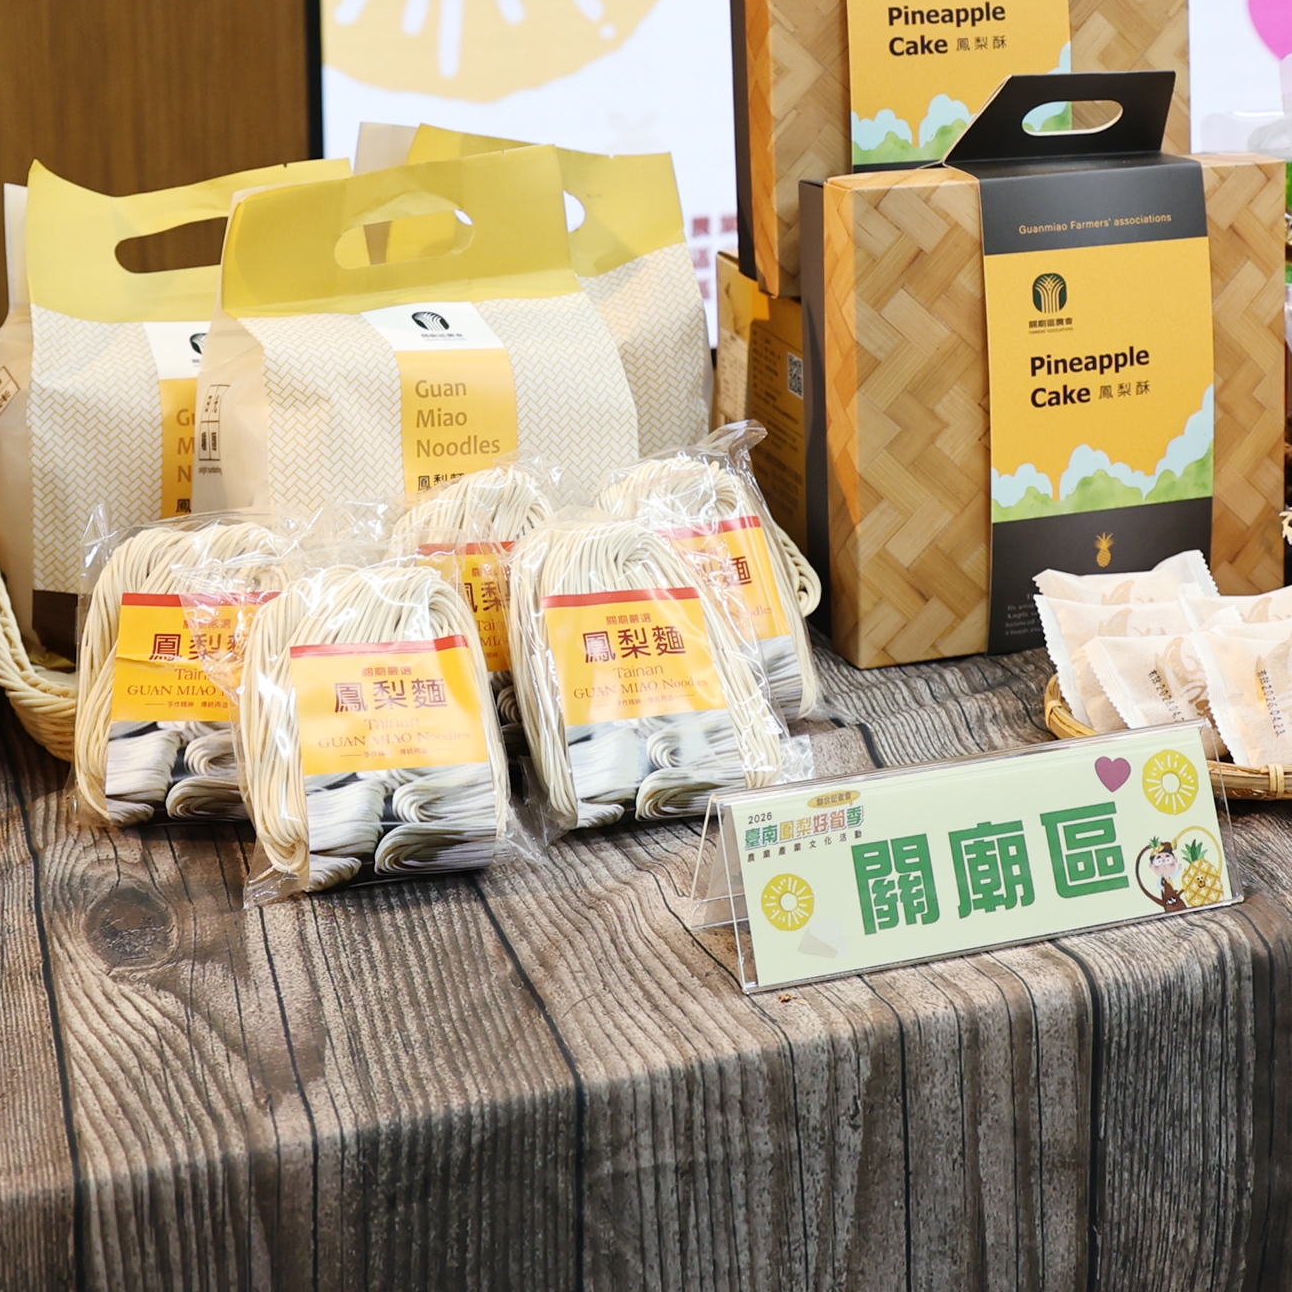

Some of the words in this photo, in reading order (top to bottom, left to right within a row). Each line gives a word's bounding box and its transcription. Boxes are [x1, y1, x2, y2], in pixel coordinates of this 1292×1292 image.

[888, 1, 1006, 28] Pineapple
[889, 35, 948, 57] Cake
[956, 35, 1007, 51] 鳳梨酥
[1018, 224, 1067, 235] Guanmiao
[1070, 218, 1112, 230] Farmers'
[1113, 213, 1172, 227] associations
[1030, 346, 1150, 377] Pineapple
[415, 380, 467, 399] Guan
[1030, 384, 1091, 409] Cake
[1099, 380, 1150, 400] 鳳梨酥
[416, 407, 468, 428] Miao
[416, 435, 501, 458] Noodles
[582, 625, 686, 664] 鳳梨麵
[612, 665, 664, 679] Tainan
[127, 685, 173, 696] GUAN
[176, 685, 217, 696] MIAO
[334, 678, 448, 713] 鳳梨麵
[573, 686, 617, 699] GUAN
[621, 680, 658, 695] MIAO
[363, 717, 420, 731] Tainan
[318, 735, 366, 749] GUAN
[371, 732, 412, 745] MIAO
[417, 731, 470, 744] Noodles
[816, 793, 852, 807] 聯合記者會
[744, 805, 862, 848] 臺南鳳梨好筍季
[748, 811, 773, 825] 2026
[850, 800, 1130, 936] 關廟區
